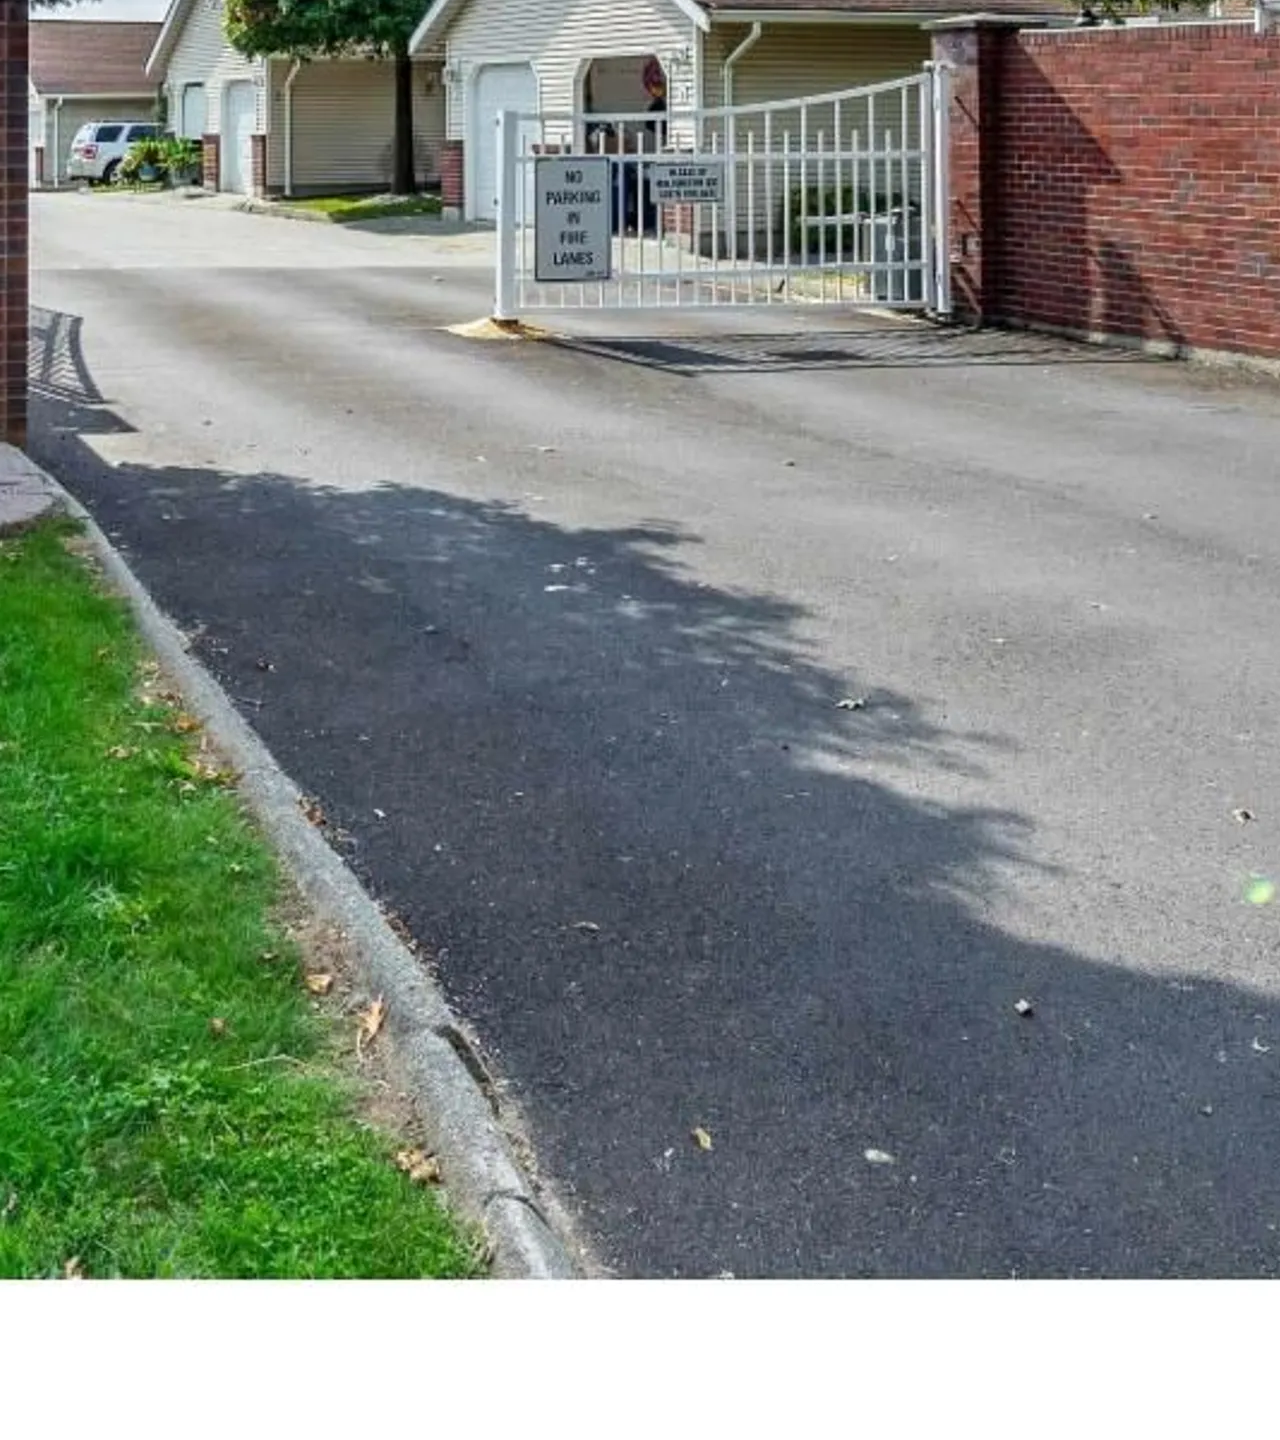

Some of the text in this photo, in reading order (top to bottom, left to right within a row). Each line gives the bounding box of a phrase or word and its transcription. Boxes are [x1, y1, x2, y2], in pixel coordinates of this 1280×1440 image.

[565, 169, 583, 184] NO
[546, 190, 601, 206] PARKING
[567, 211, 581, 225] IN
[553, 251, 594, 266] LANES
